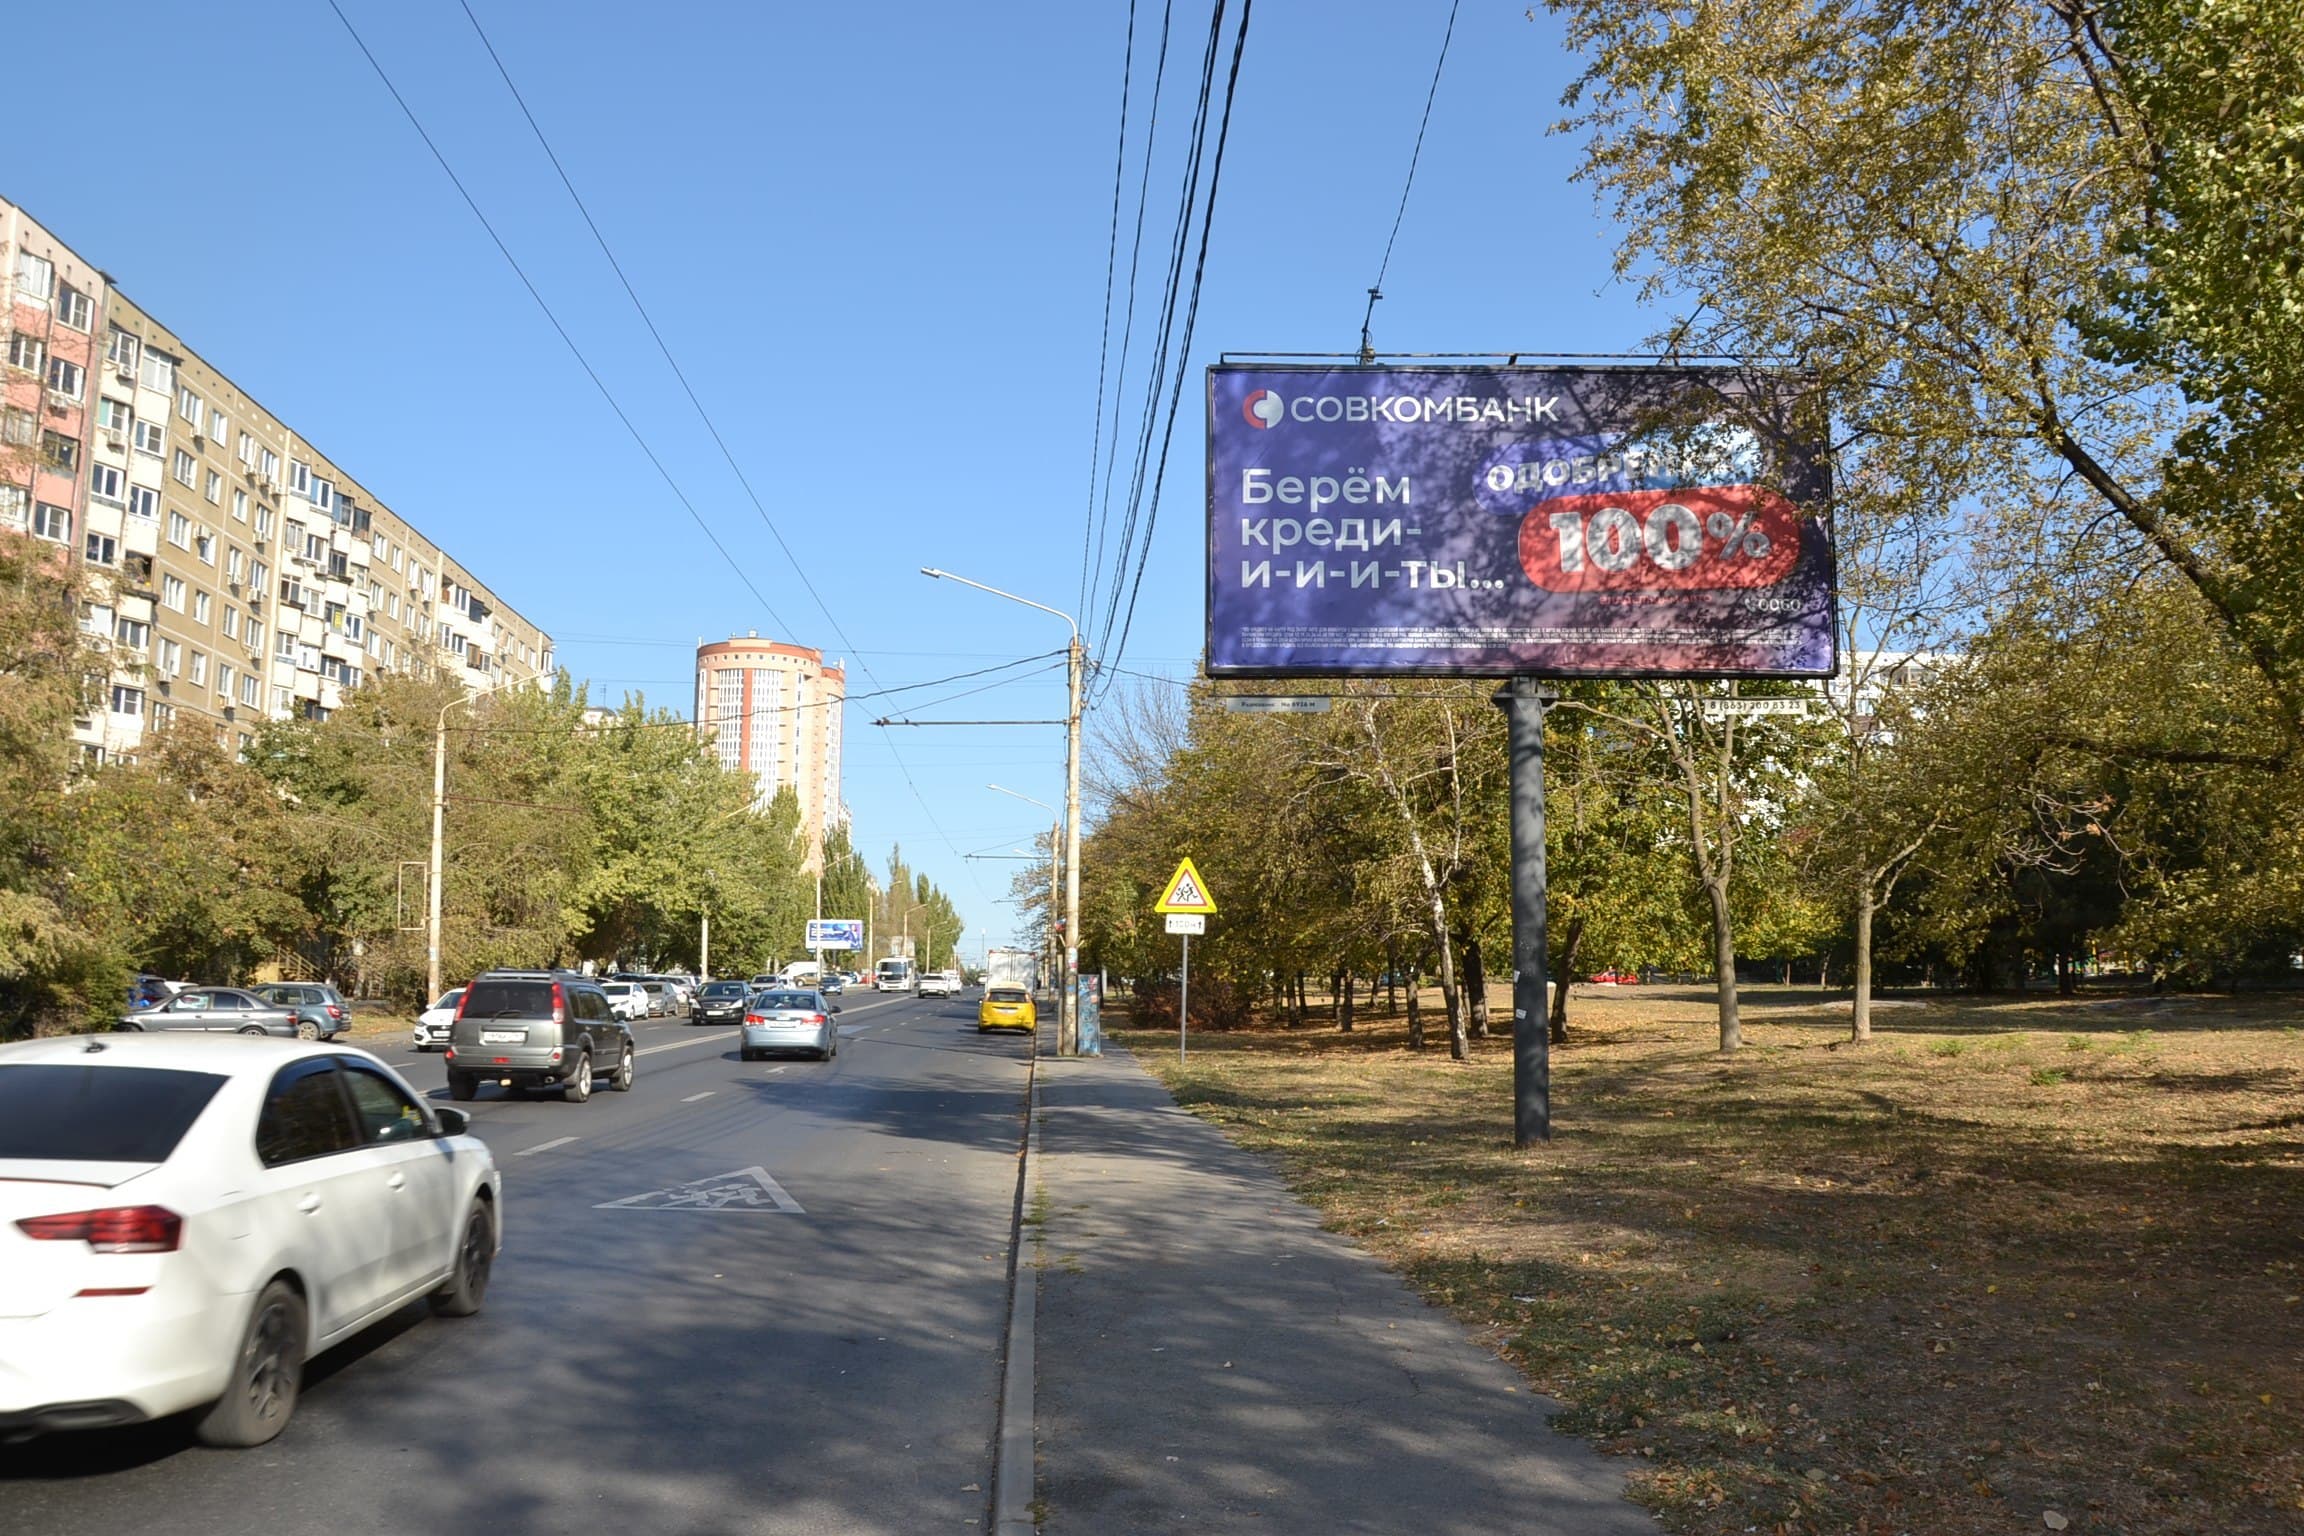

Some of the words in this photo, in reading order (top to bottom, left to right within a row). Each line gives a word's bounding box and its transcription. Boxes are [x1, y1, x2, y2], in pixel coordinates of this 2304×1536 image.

[1290, 396, 1560, 423] СОВКОМБАНК
[1242, 467, 1411, 513] Берём
[1487, 450, 1734, 494] ОДОБРЕН
[1241, 518, 1422, 555] креди-
[1549, 503, 1770, 573] 100%
[1241, 560, 1505, 589] и-и-и-ты...
[1710, 701, 1716, 710] 8
